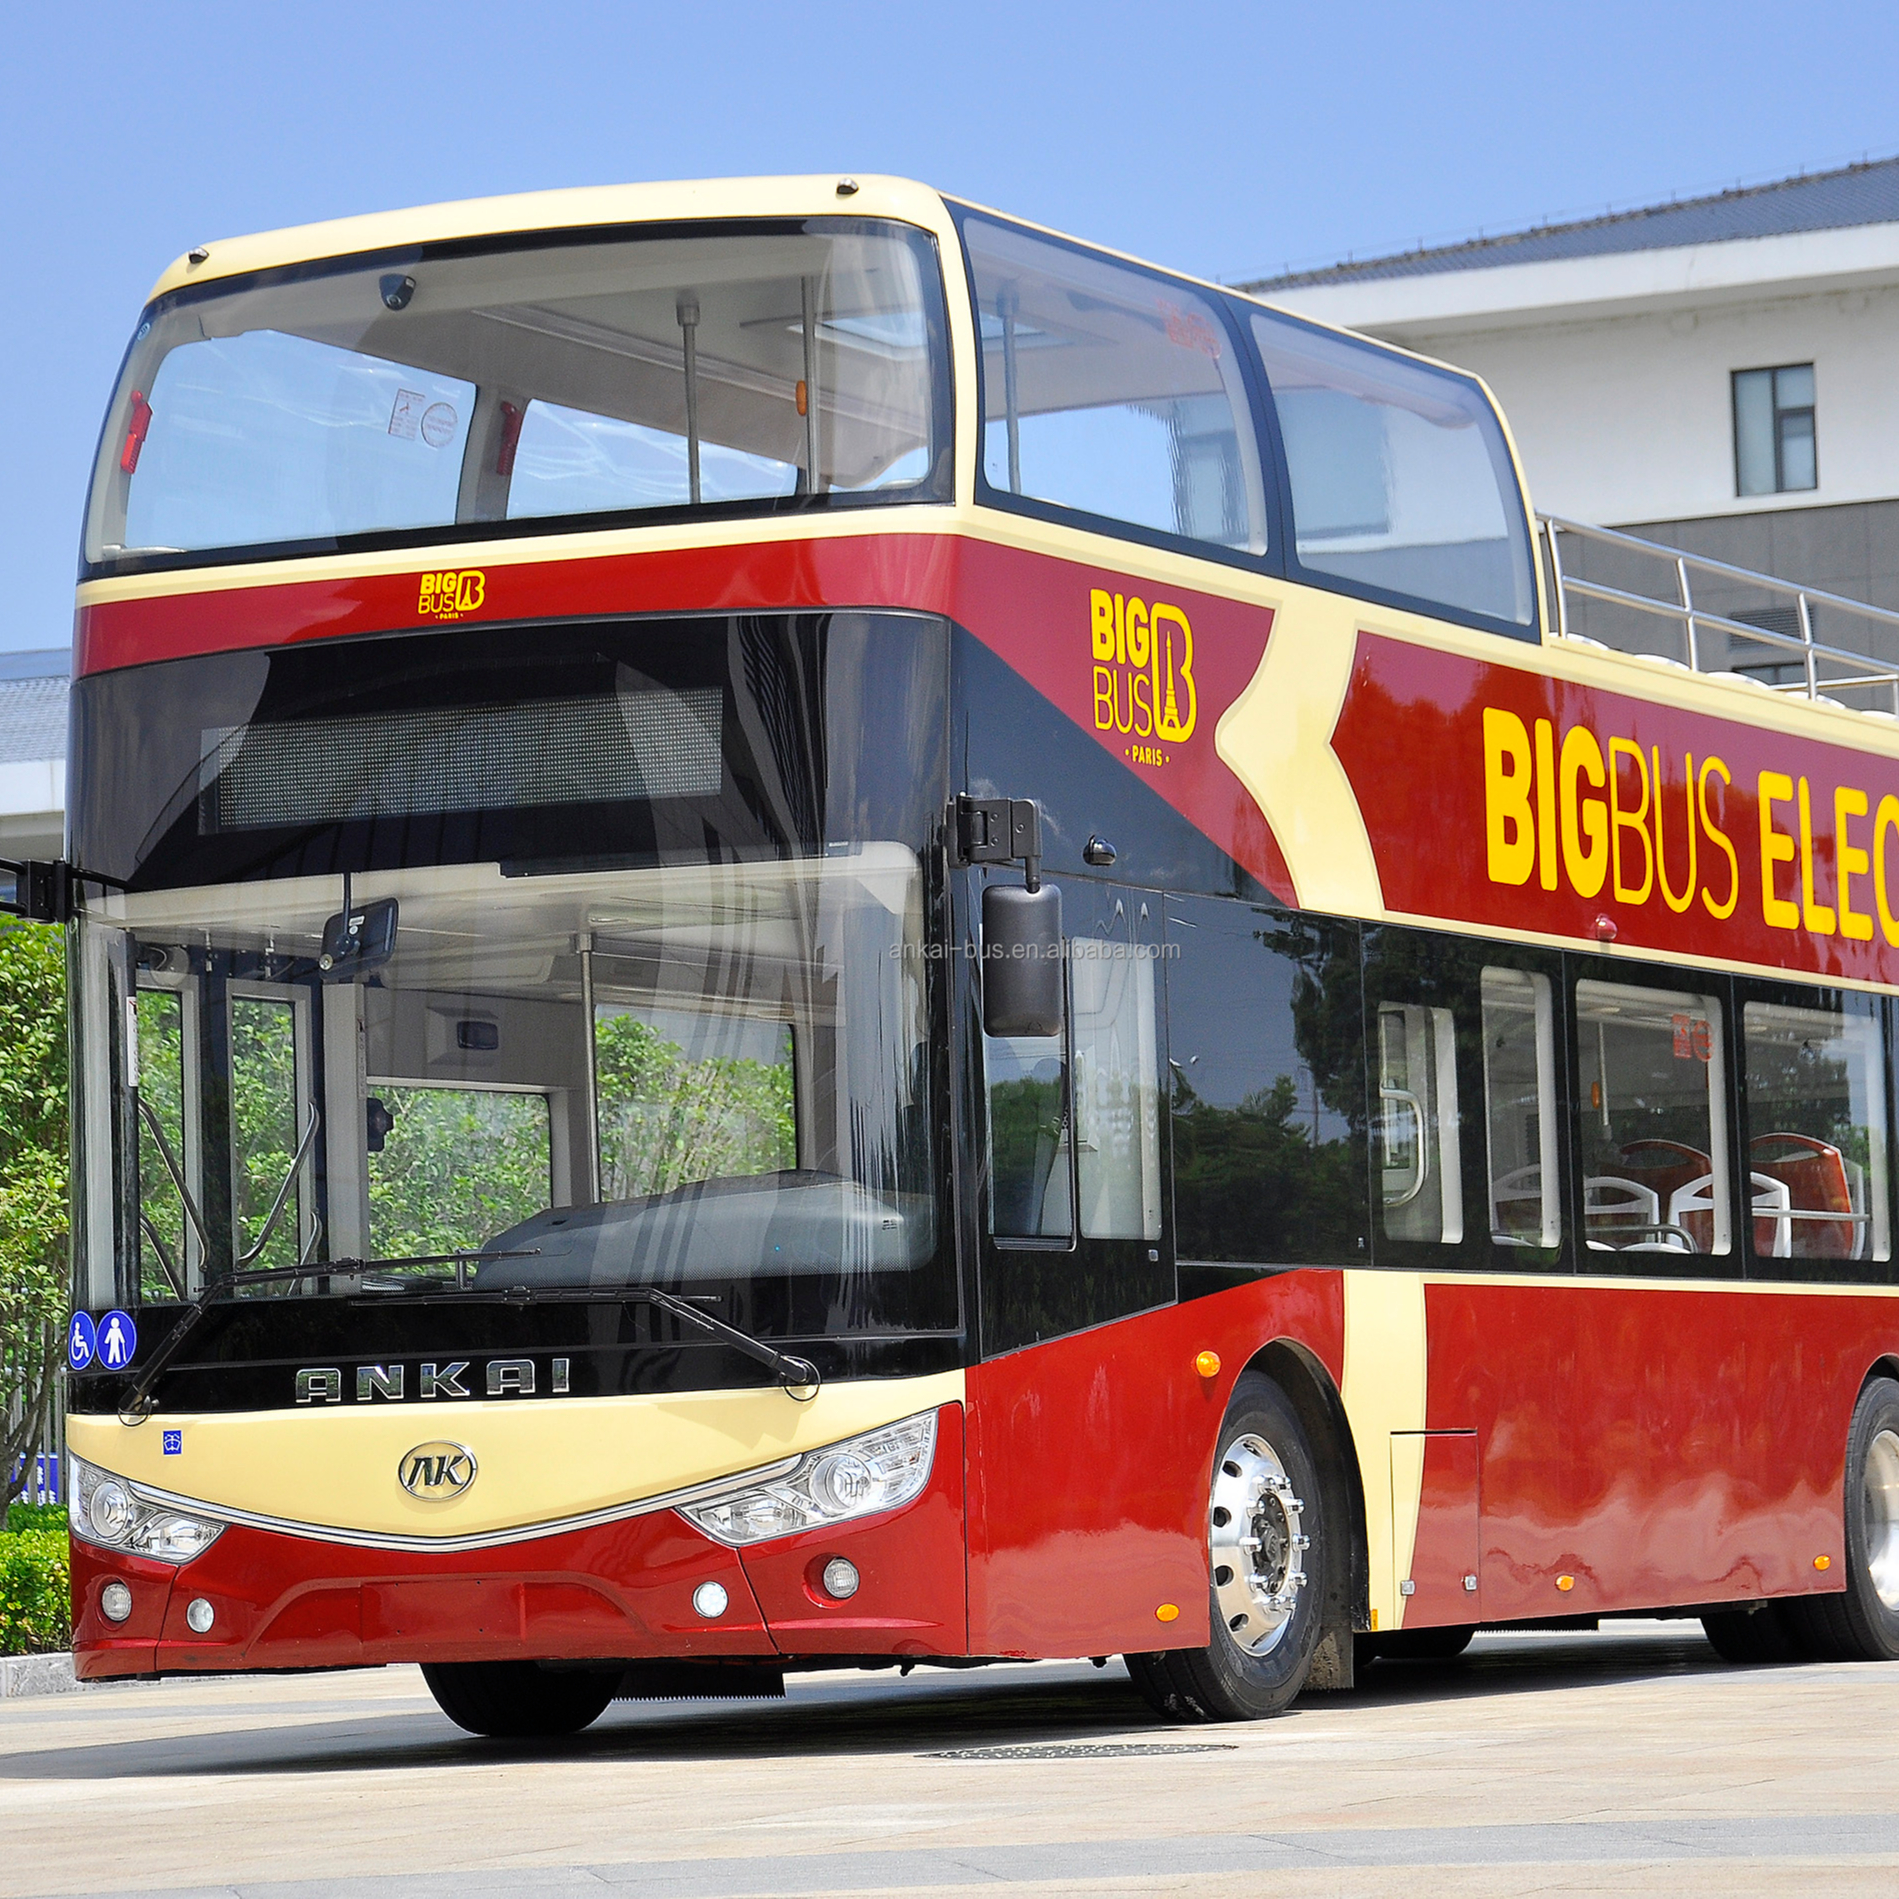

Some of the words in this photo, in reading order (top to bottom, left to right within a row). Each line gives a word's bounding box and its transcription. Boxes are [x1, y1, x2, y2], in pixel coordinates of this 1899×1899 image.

[420, 572, 457, 594] BIG
[418, 593, 454, 615] BUS
[1090, 588, 1150, 669] BIG
[1093, 665, 1152, 738] BUS
[1132, 744, 1163, 767] PARIS
[296, 1358, 570, 1403] ANKAI
